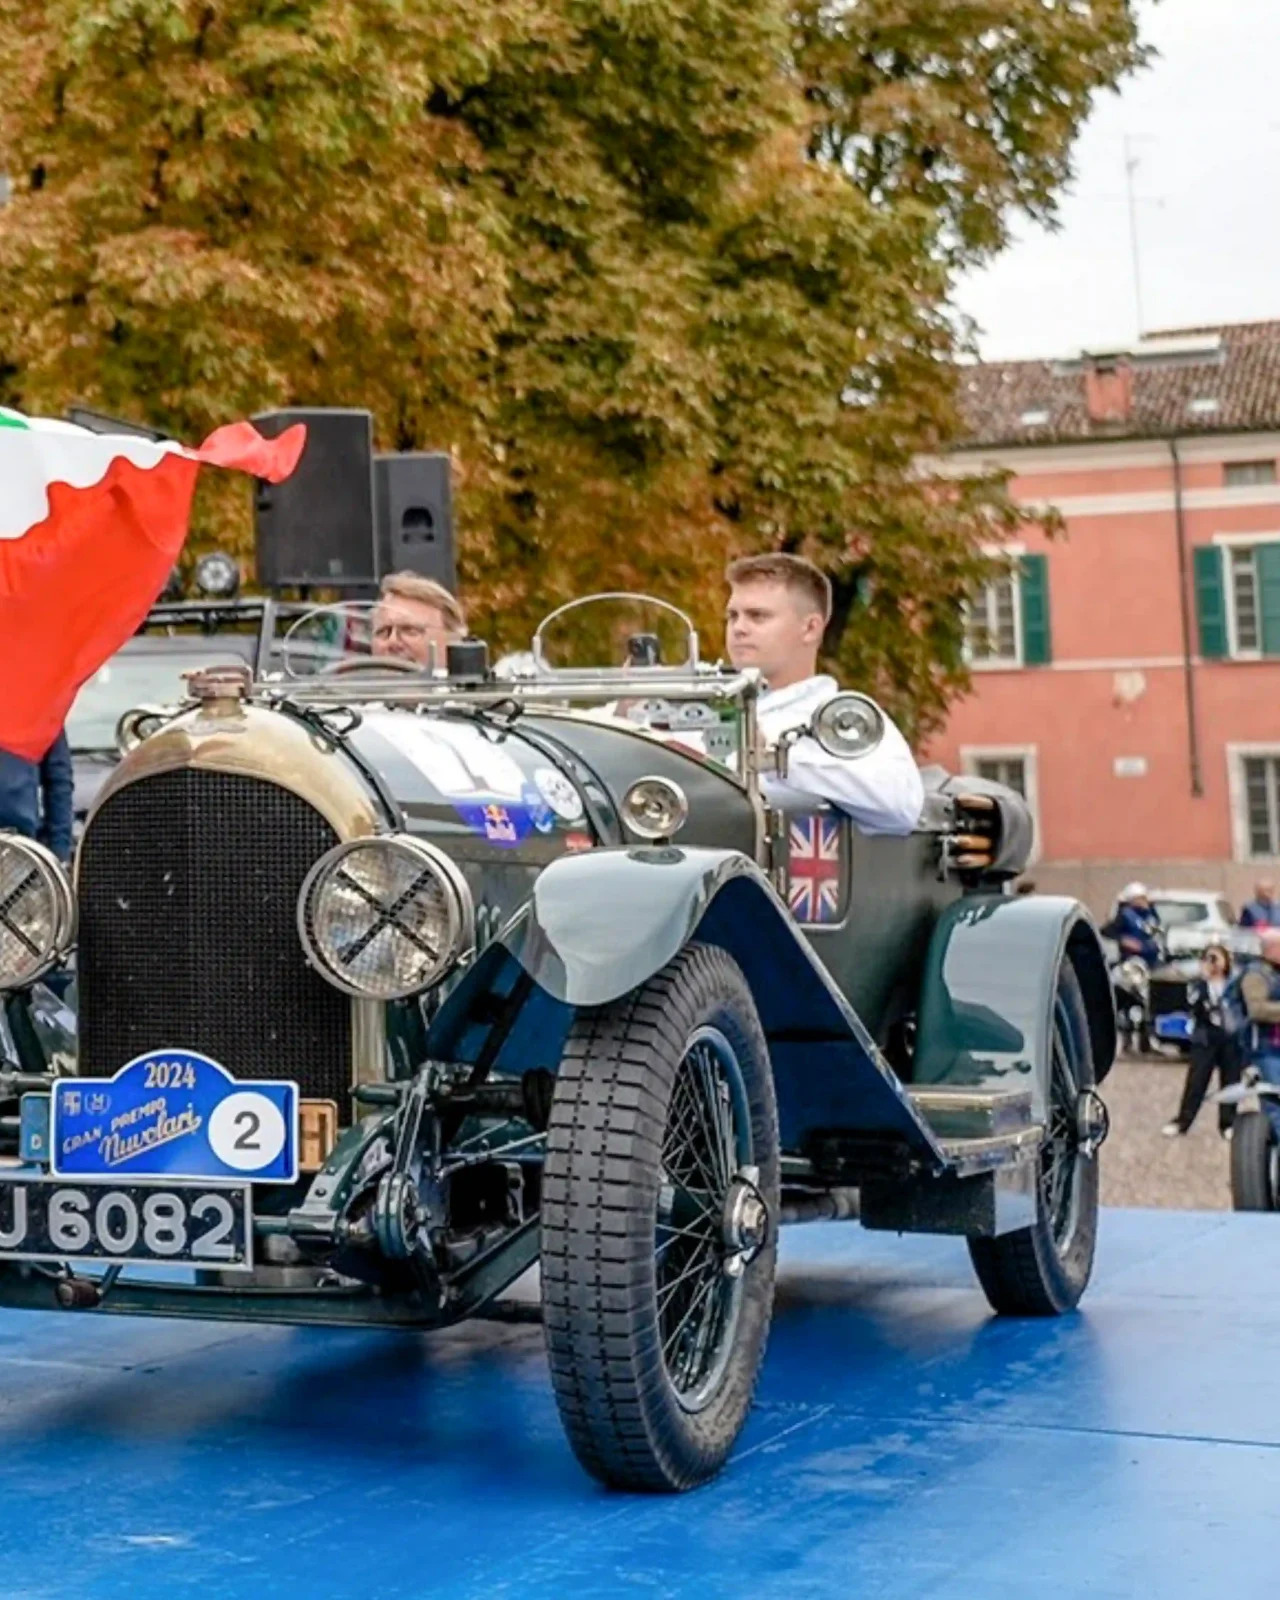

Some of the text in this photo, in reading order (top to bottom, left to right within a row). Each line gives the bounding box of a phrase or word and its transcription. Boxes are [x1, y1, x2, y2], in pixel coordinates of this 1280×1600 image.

[143, 1061, 197, 1090] 2024
[62, 1125, 103, 1155] GRAN
[110, 1096, 167, 1132] PREMIO
[97, 1102, 203, 1166] Nuvolari
[232, 1111, 262, 1151] 2
[47, 1188, 237, 1259] 6082
